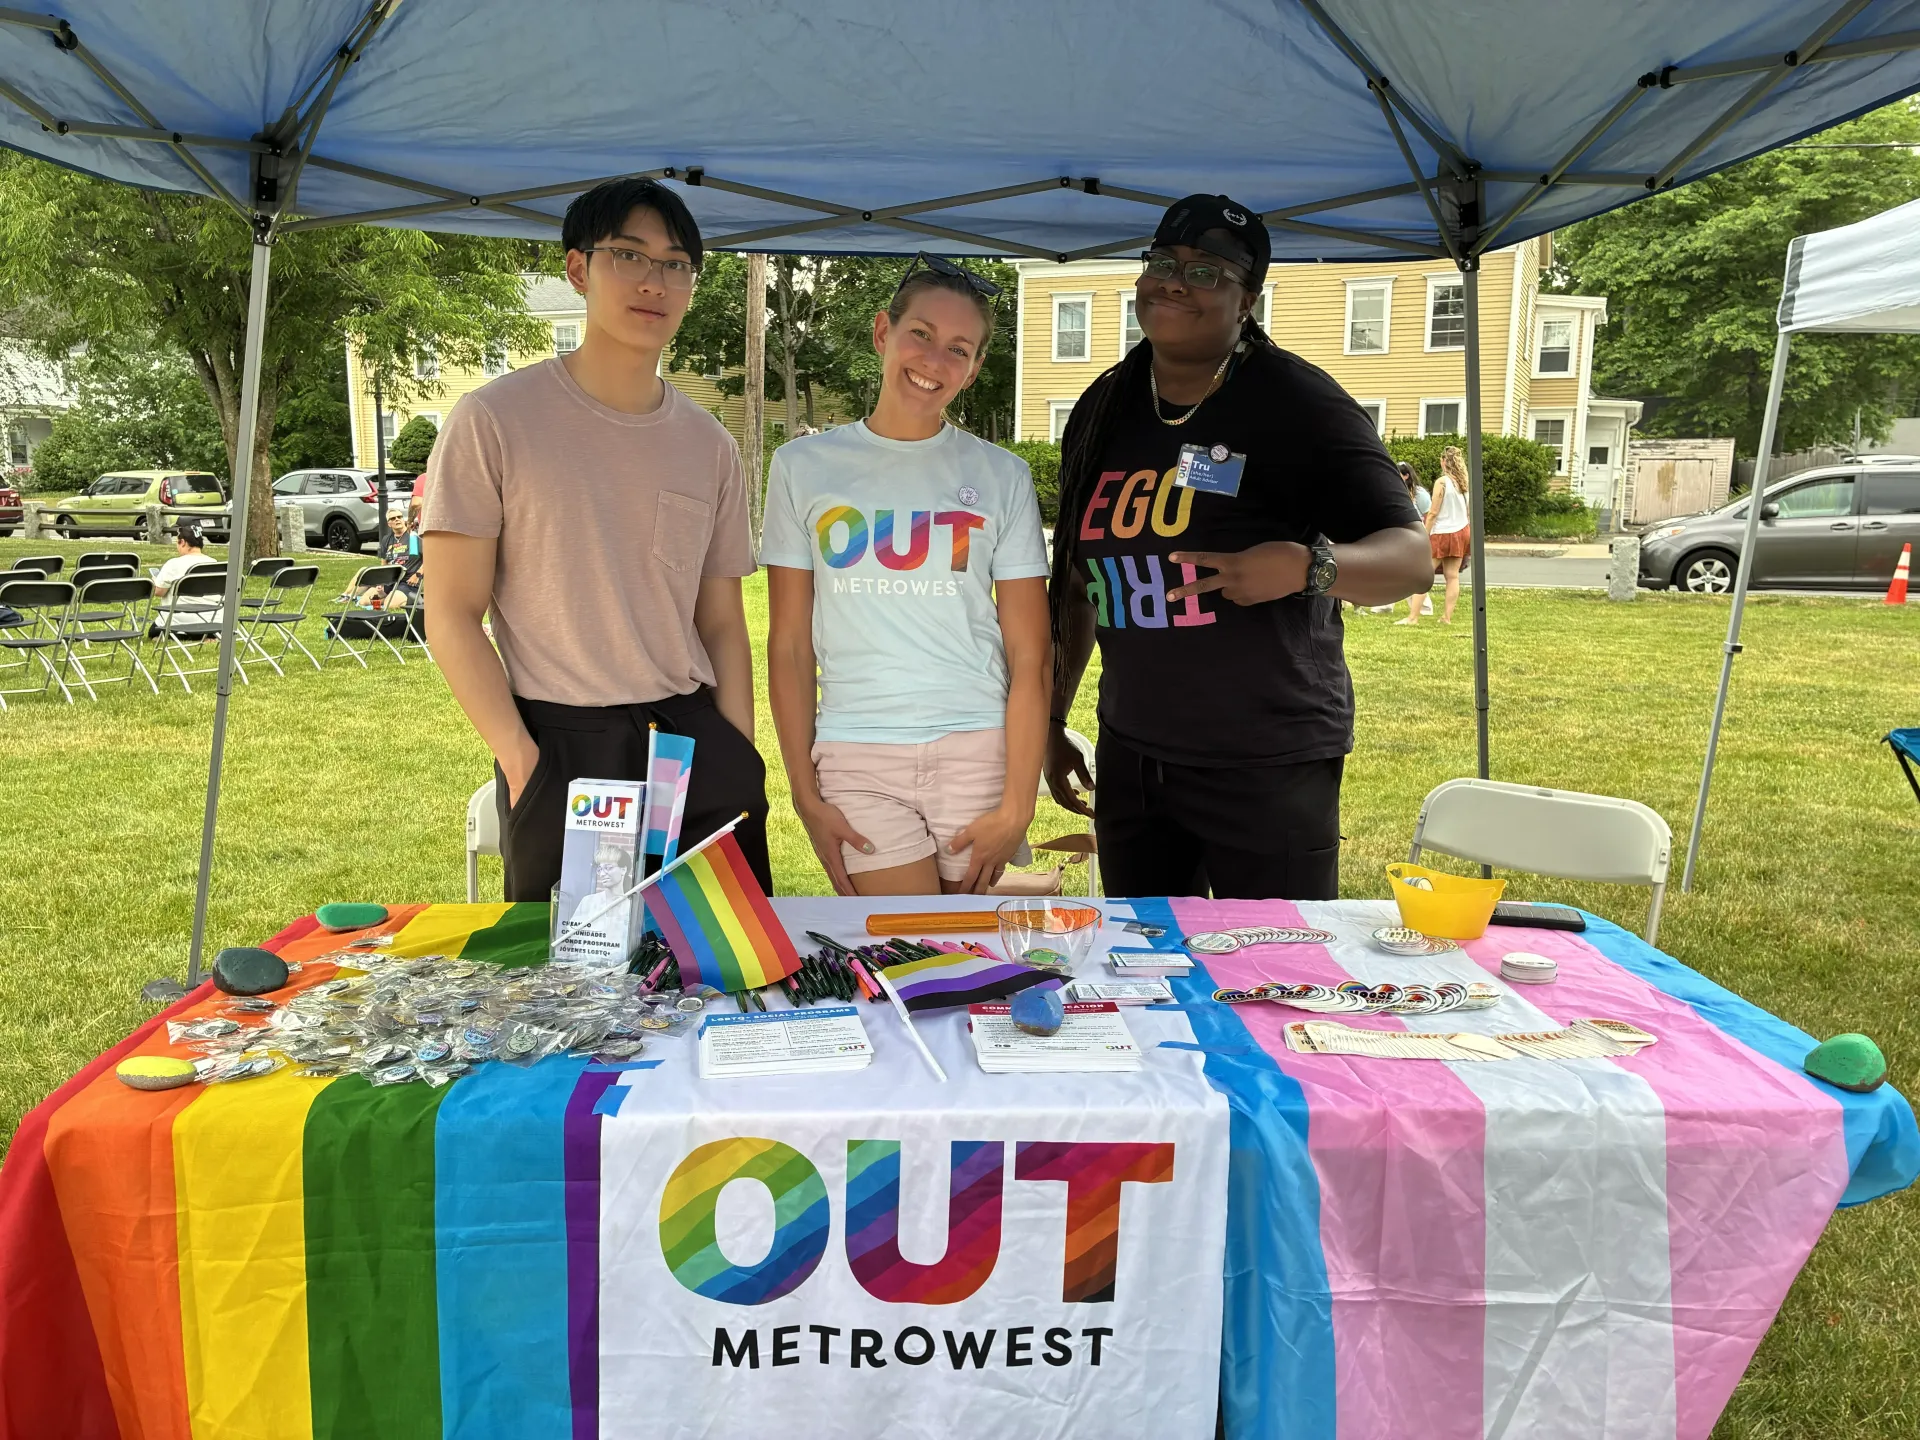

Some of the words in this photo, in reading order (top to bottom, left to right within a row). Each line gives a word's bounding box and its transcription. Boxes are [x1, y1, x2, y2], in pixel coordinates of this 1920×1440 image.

[1178, 459, 1189, 478] OUT
[1192, 460, 1210, 471] Tru
[1080, 466, 1196, 541] EGO
[816, 505, 986, 573] OUT
[1086, 554, 1217, 629] TRIP
[571, 793, 633, 820] OUT
[576, 818, 625, 829] METROWEST
[561, 920, 592, 928] CEAO
[561, 929, 607, 938] COUNIDADES
[1345, 989, 1395, 1000] HOOSE
[793, 1008, 851, 1016] PROGRAMS
[658, 1136, 1176, 1306] OUT
[711, 1325, 1114, 1370] METROWEST
